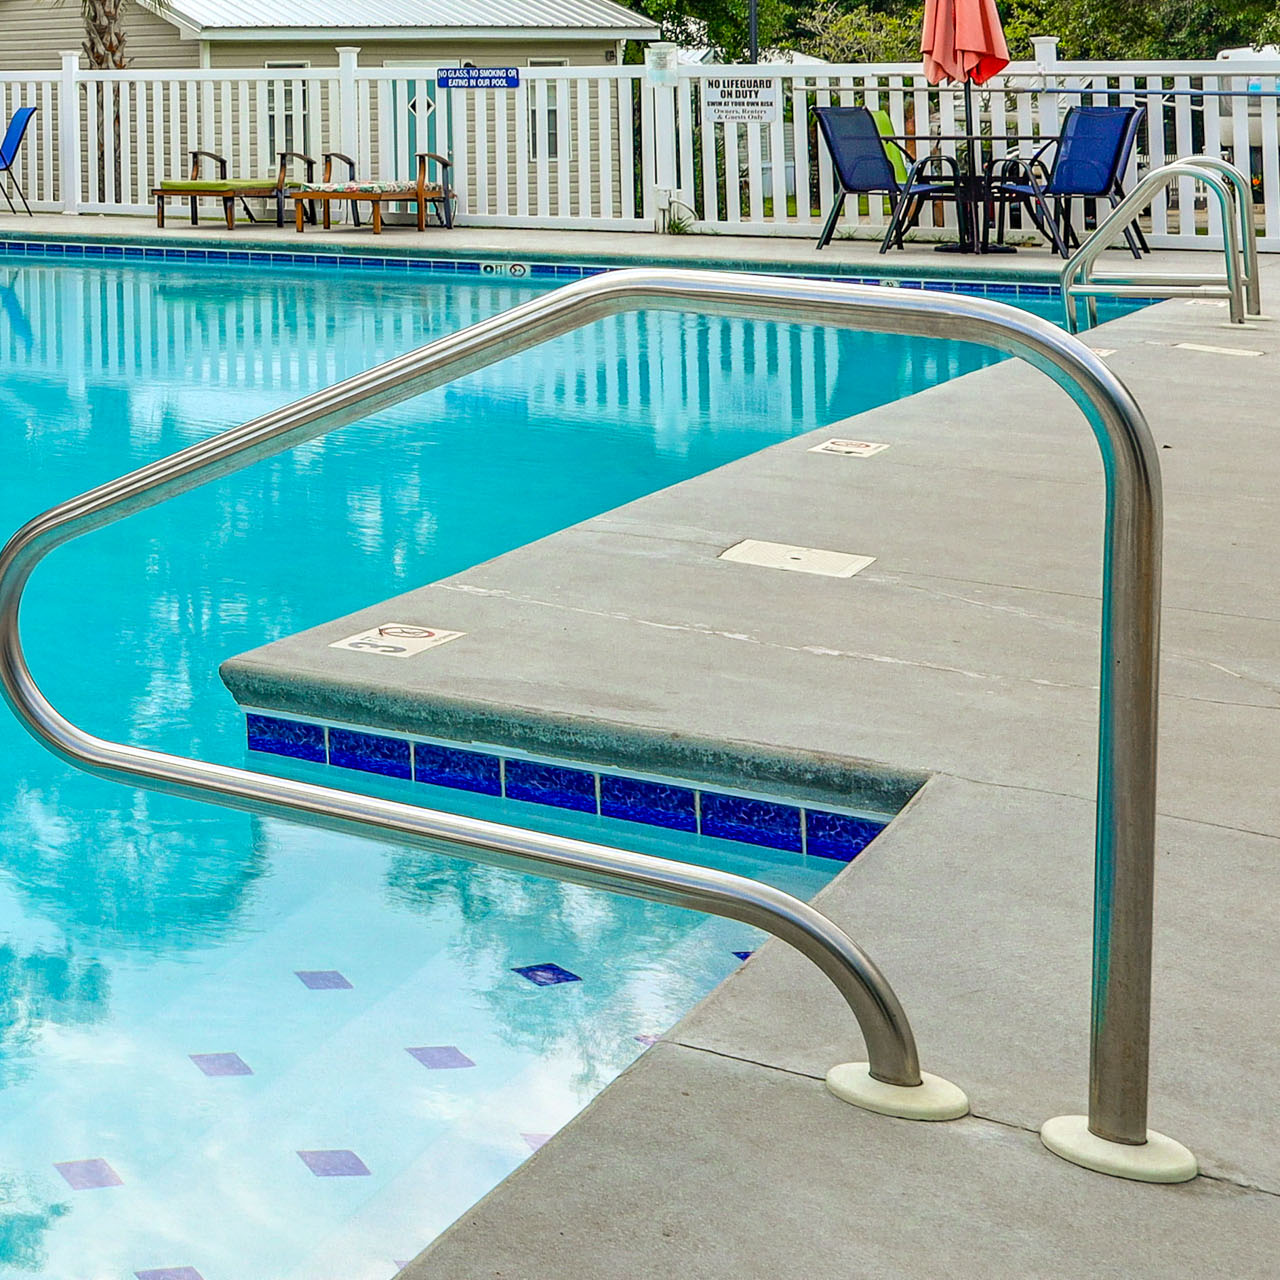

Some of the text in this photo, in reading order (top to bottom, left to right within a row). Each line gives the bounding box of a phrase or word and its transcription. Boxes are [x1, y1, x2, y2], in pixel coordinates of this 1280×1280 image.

[438, 69, 447, 78] NO
[470, 69, 478, 77] NO
[480, 69, 506, 77] SMOKING
[507, 69, 517, 79] OR
[448, 78, 468, 86] EATING
[470, 78, 476, 86] IN
[491, 78, 508, 86] POOL
[708, 80, 772, 88] NO LIFEGUARD
[720, 90, 759, 99] ON DUTY
